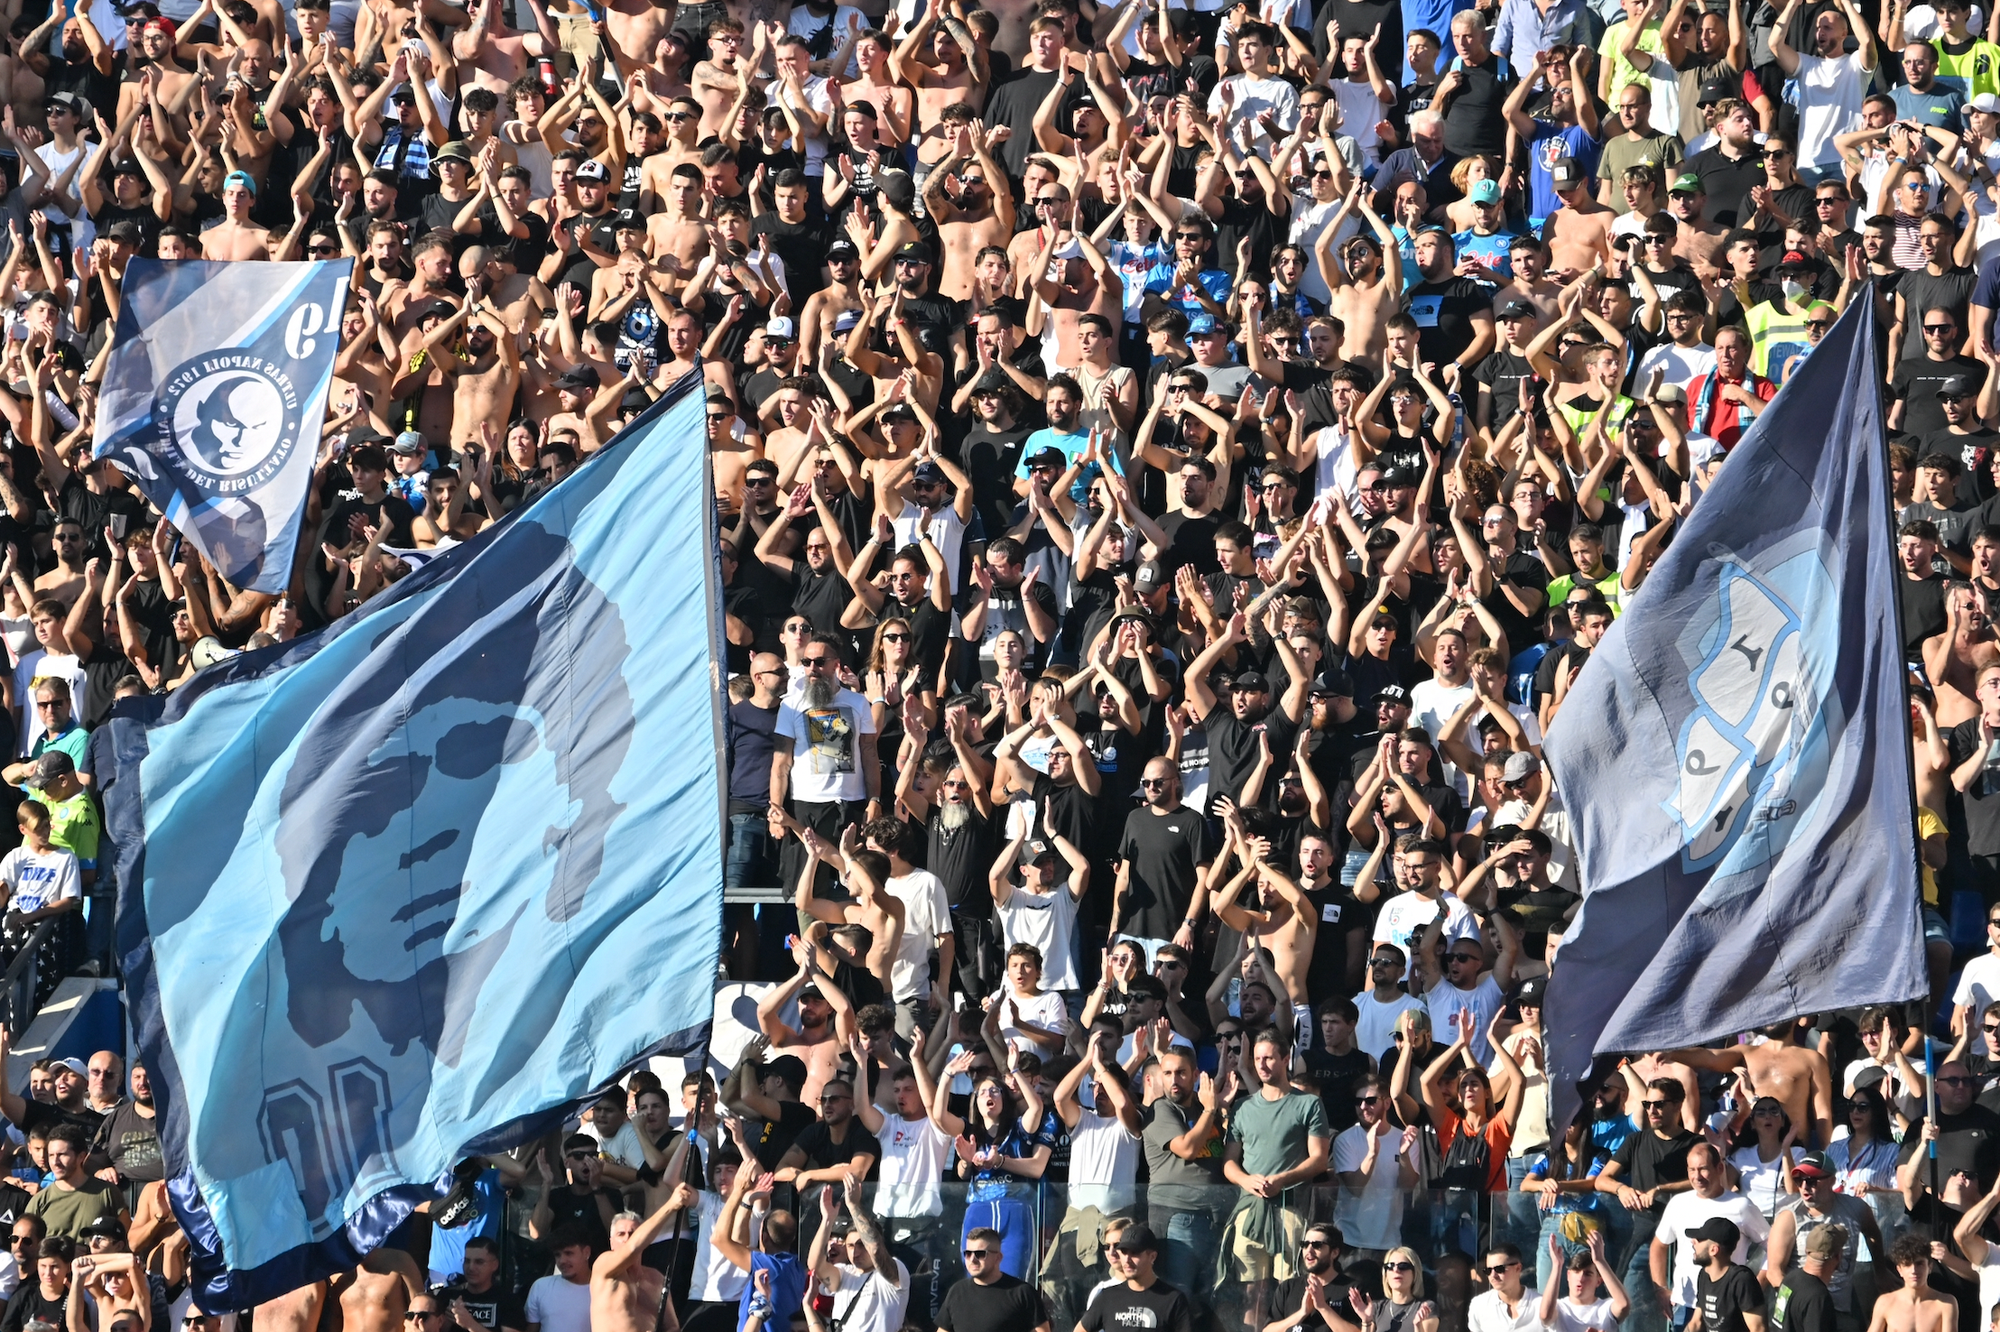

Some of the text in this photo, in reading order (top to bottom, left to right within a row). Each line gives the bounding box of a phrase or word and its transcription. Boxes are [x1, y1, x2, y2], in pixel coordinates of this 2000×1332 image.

[440, 1197, 470, 1226] adidas
[929, 1258, 941, 1319] GIVOVA
[1128, 1306, 1143, 1314] THE
[1114, 1312, 1143, 1321] NORTH
[1122, 1320, 1142, 1328] FACE
